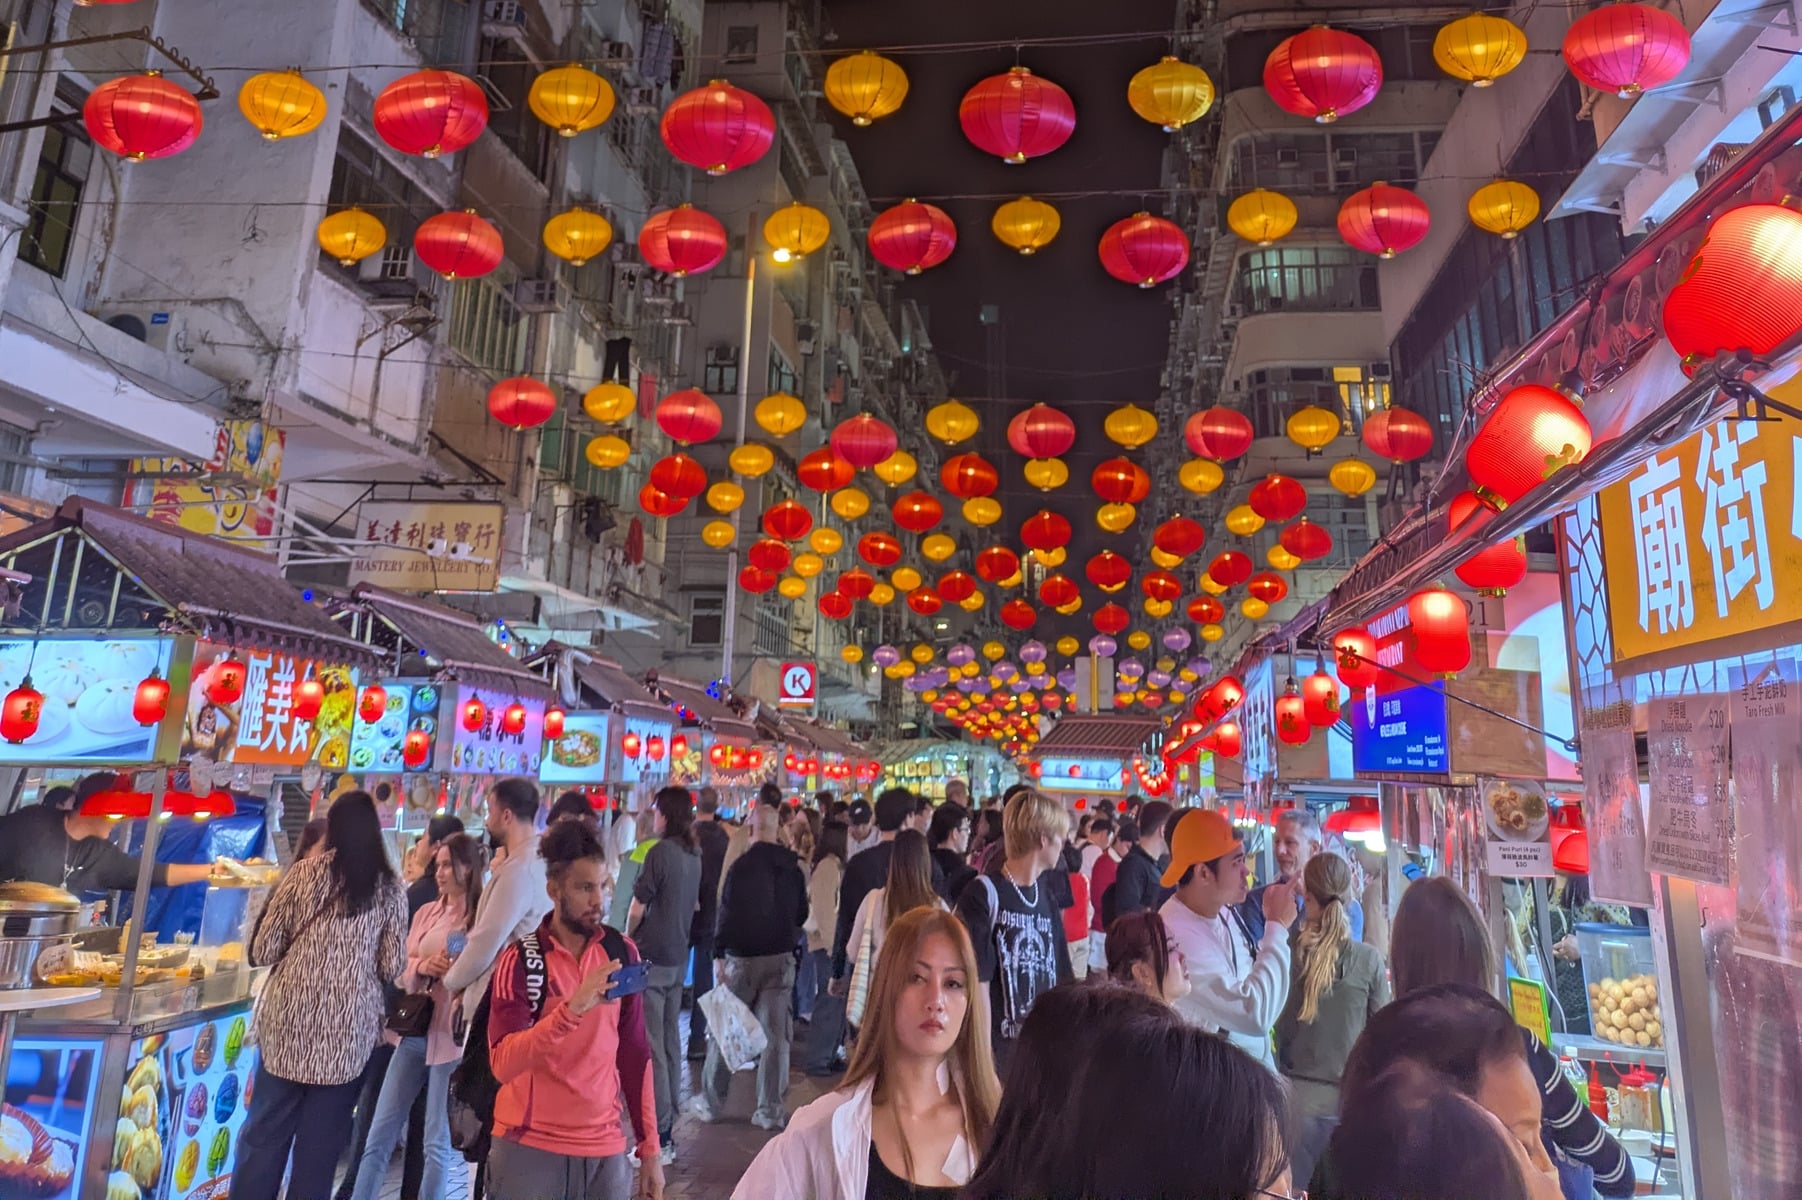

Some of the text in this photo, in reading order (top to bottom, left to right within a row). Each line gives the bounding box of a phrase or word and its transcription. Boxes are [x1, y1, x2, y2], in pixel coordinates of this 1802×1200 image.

[1629, 416, 1802, 634] 廟街
[355, 559, 405, 572] MASTERY
[1709, 708, 1725, 729] $20
[1744, 702, 1786, 718] Taro Fresh Milk
